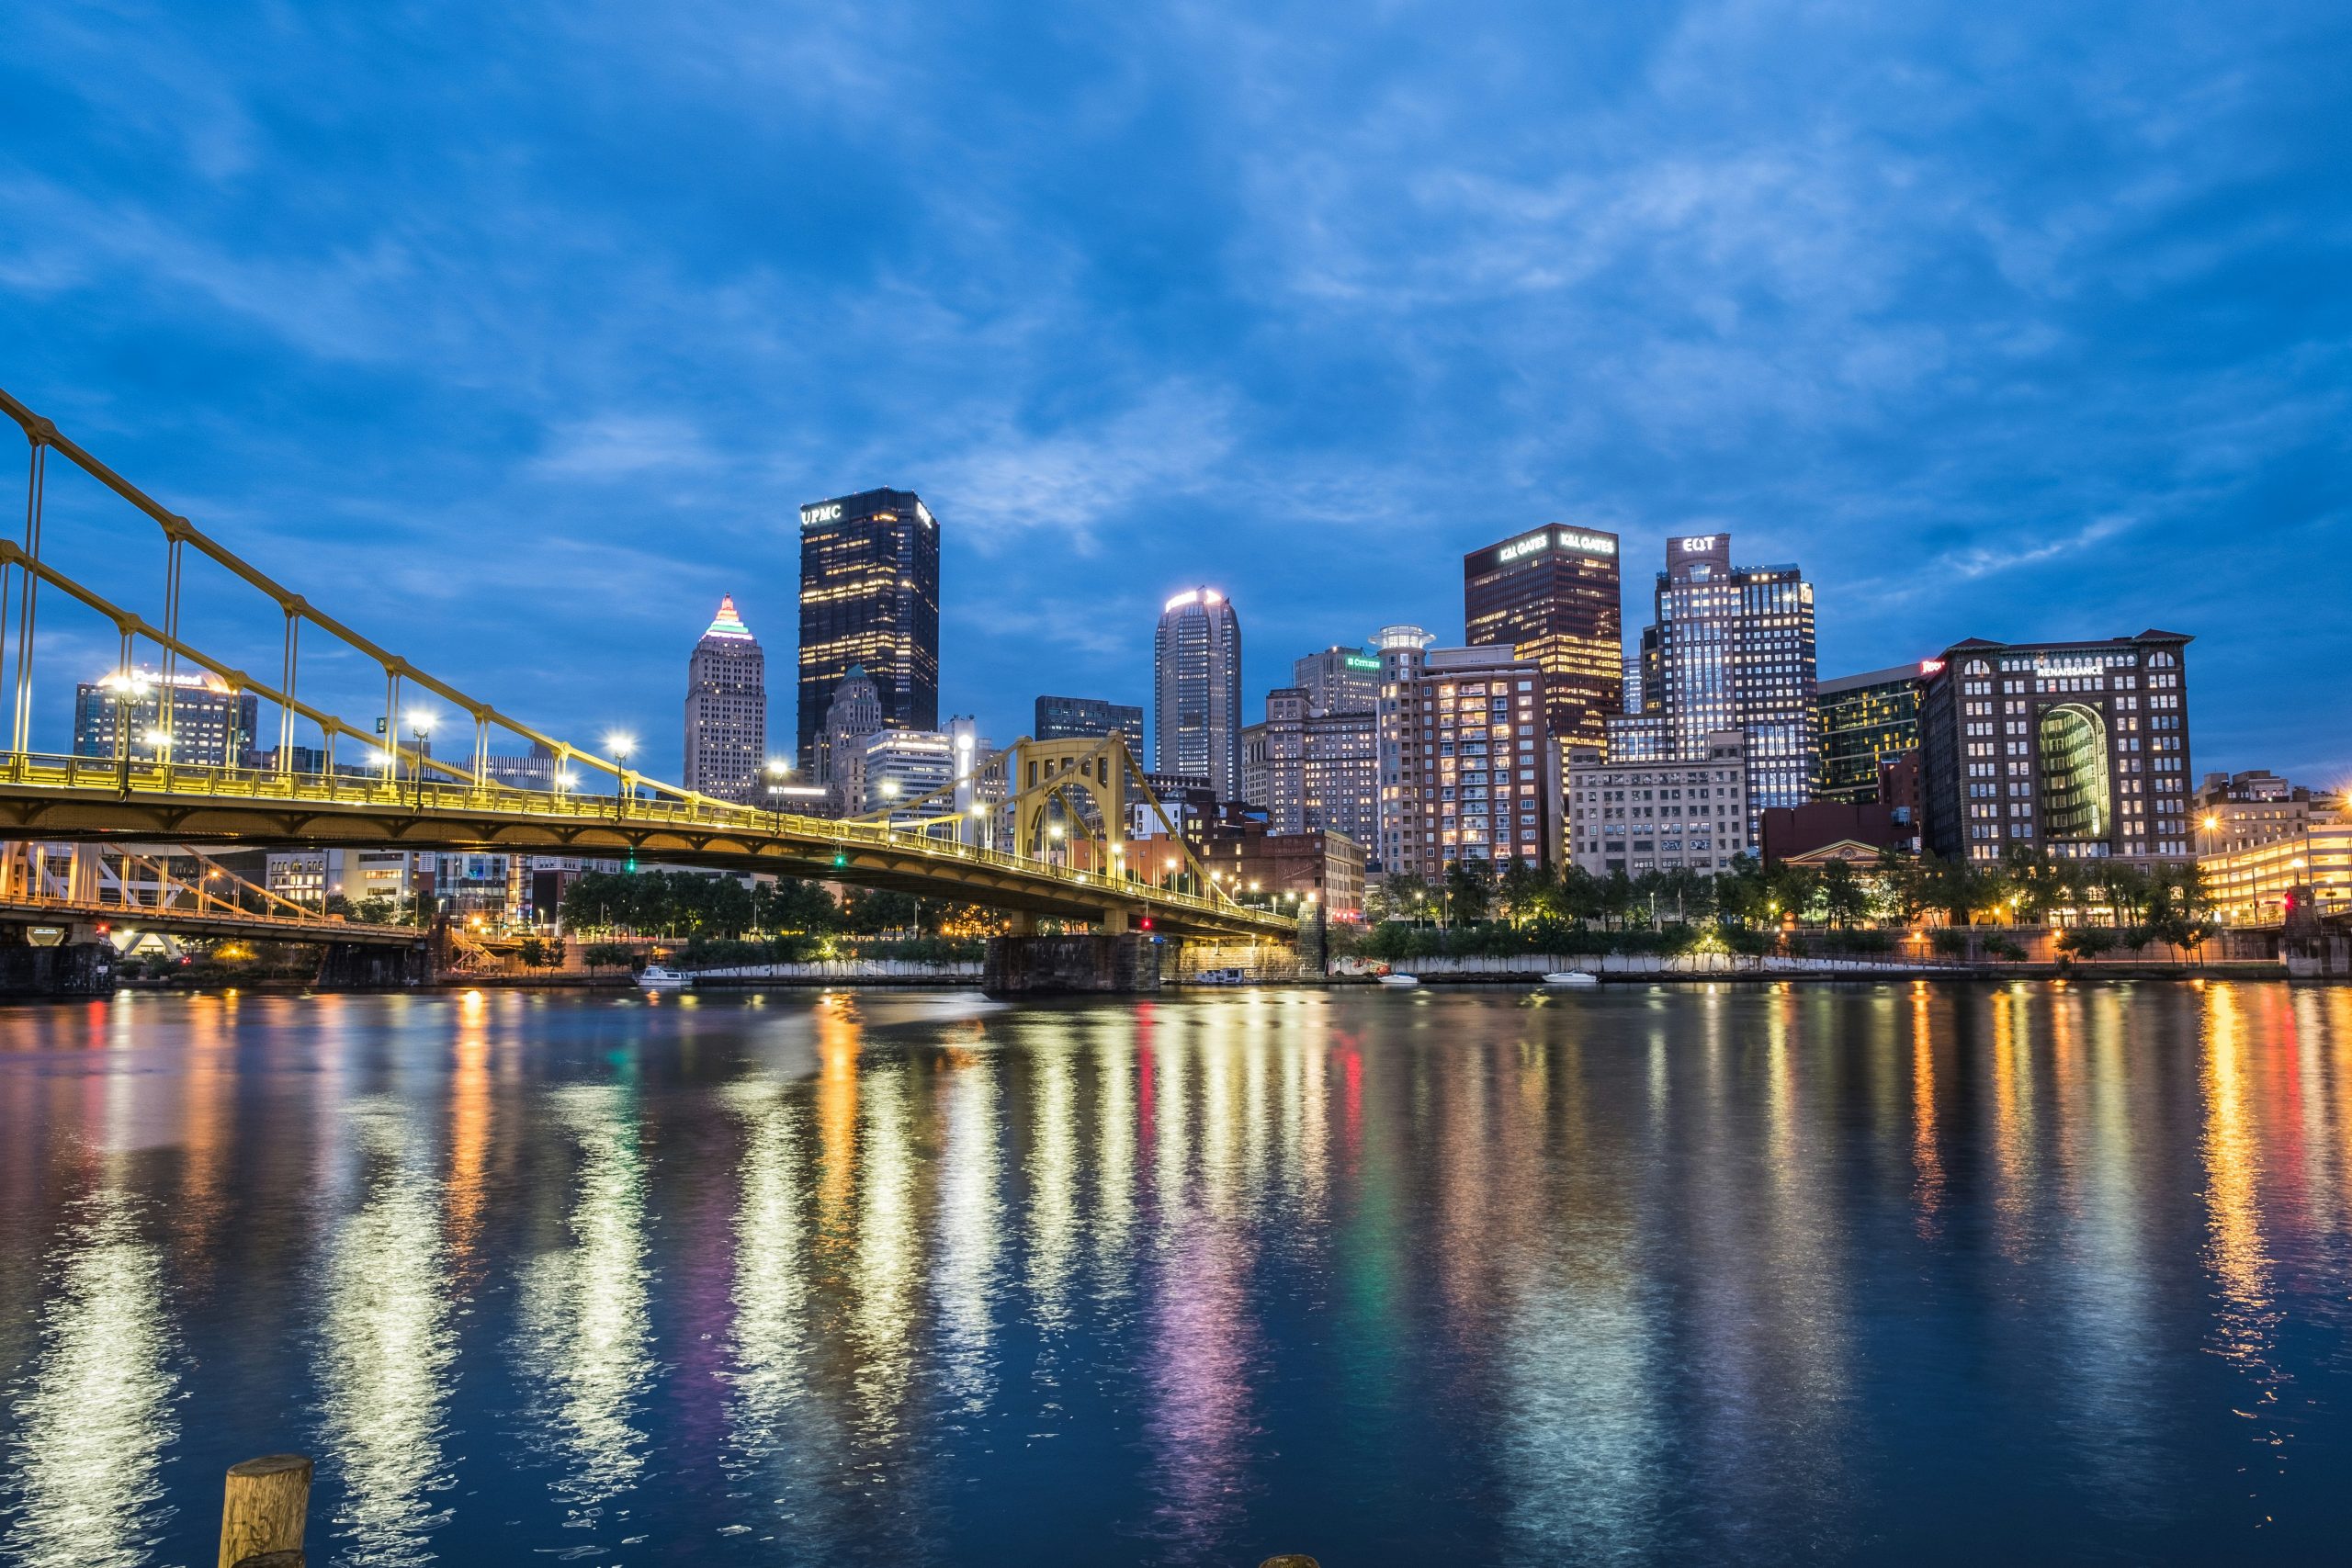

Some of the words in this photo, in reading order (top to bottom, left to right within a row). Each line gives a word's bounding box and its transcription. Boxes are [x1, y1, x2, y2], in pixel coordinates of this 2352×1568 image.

[801, 504, 841, 525] UPMC
[1517, 535, 1547, 555] GATES
[1580, 536, 1614, 553] GATES
[1683, 536, 1715, 551] EQT
[2037, 665, 2104, 677] RENAISSANCE
